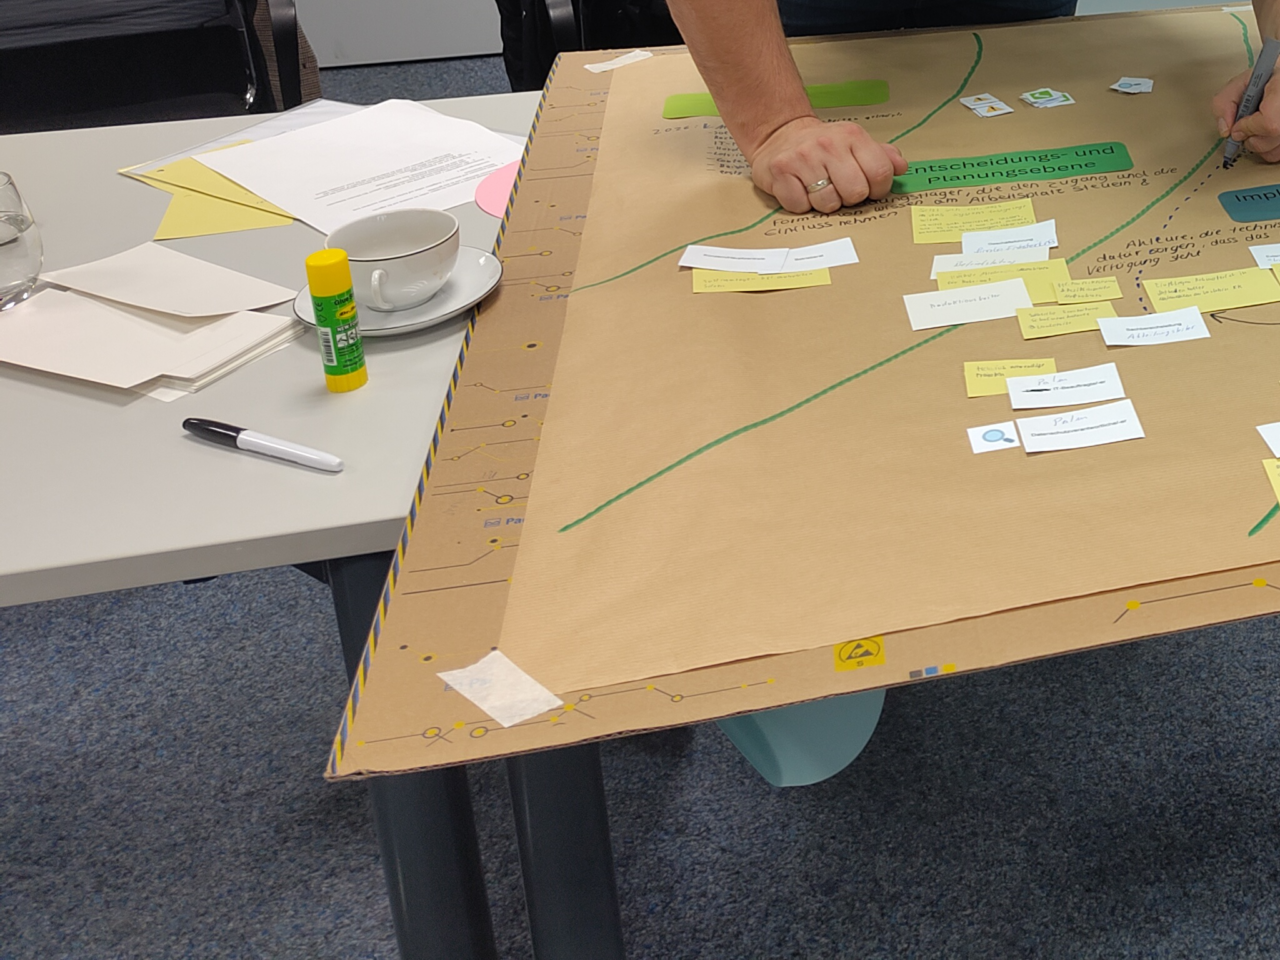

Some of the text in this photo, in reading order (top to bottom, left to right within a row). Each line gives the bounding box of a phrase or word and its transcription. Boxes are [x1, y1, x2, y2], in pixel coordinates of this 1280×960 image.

[906, 145, 1115, 176] Entscheidungs- und
[927, 160, 1096, 185] Planungsebene
[1117, 170, 1149, 180] und
[934, 196, 959, 206] am
[968, 188, 1065, 205] Arbeitsplatz
[1210, 236, 1239, 247] dass
[1245, 231, 1270, 242] das
[334, 297, 349, 306] Glue
